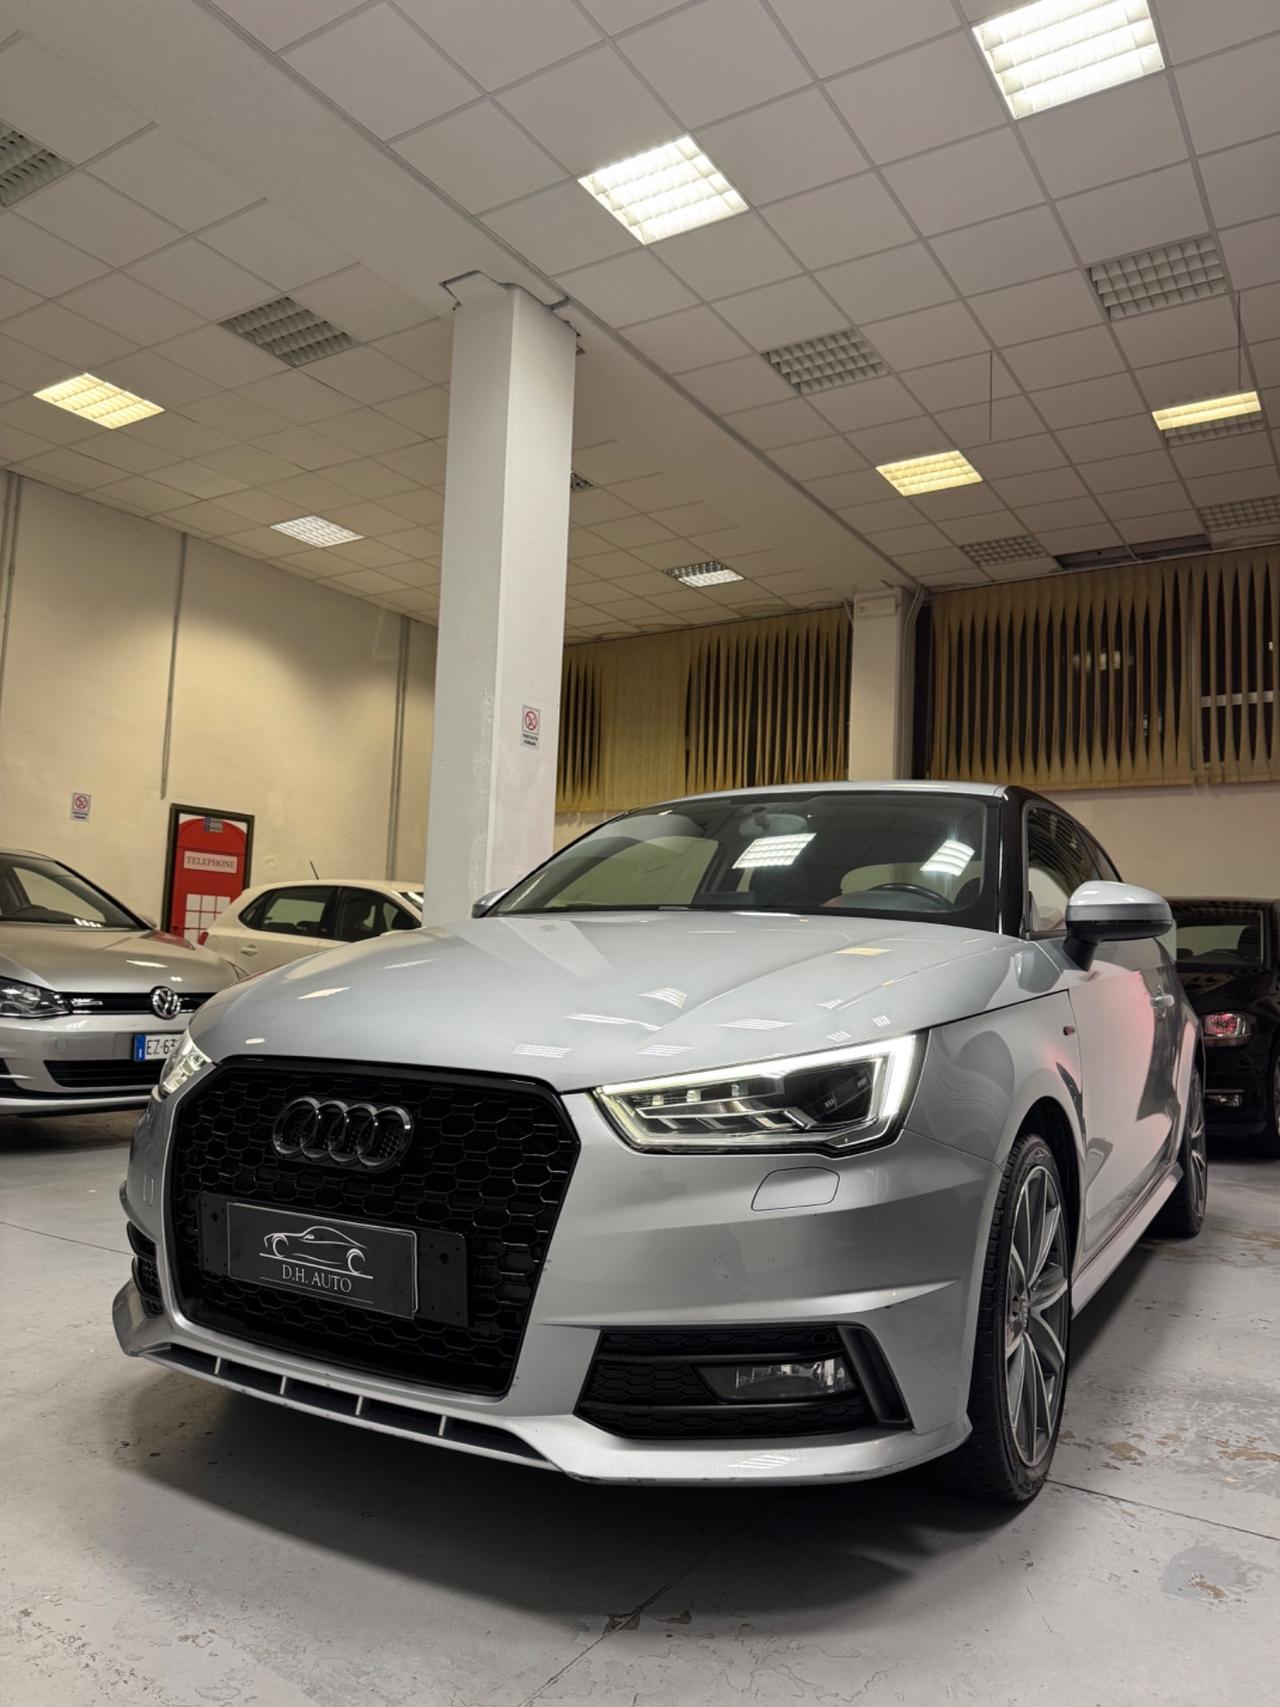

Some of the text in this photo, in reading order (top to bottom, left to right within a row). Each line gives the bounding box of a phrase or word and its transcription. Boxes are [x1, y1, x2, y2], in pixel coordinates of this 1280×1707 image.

[186, 856, 236, 869] TELEPHONE
[282, 1264, 352, 1293] D.H. AUTO
